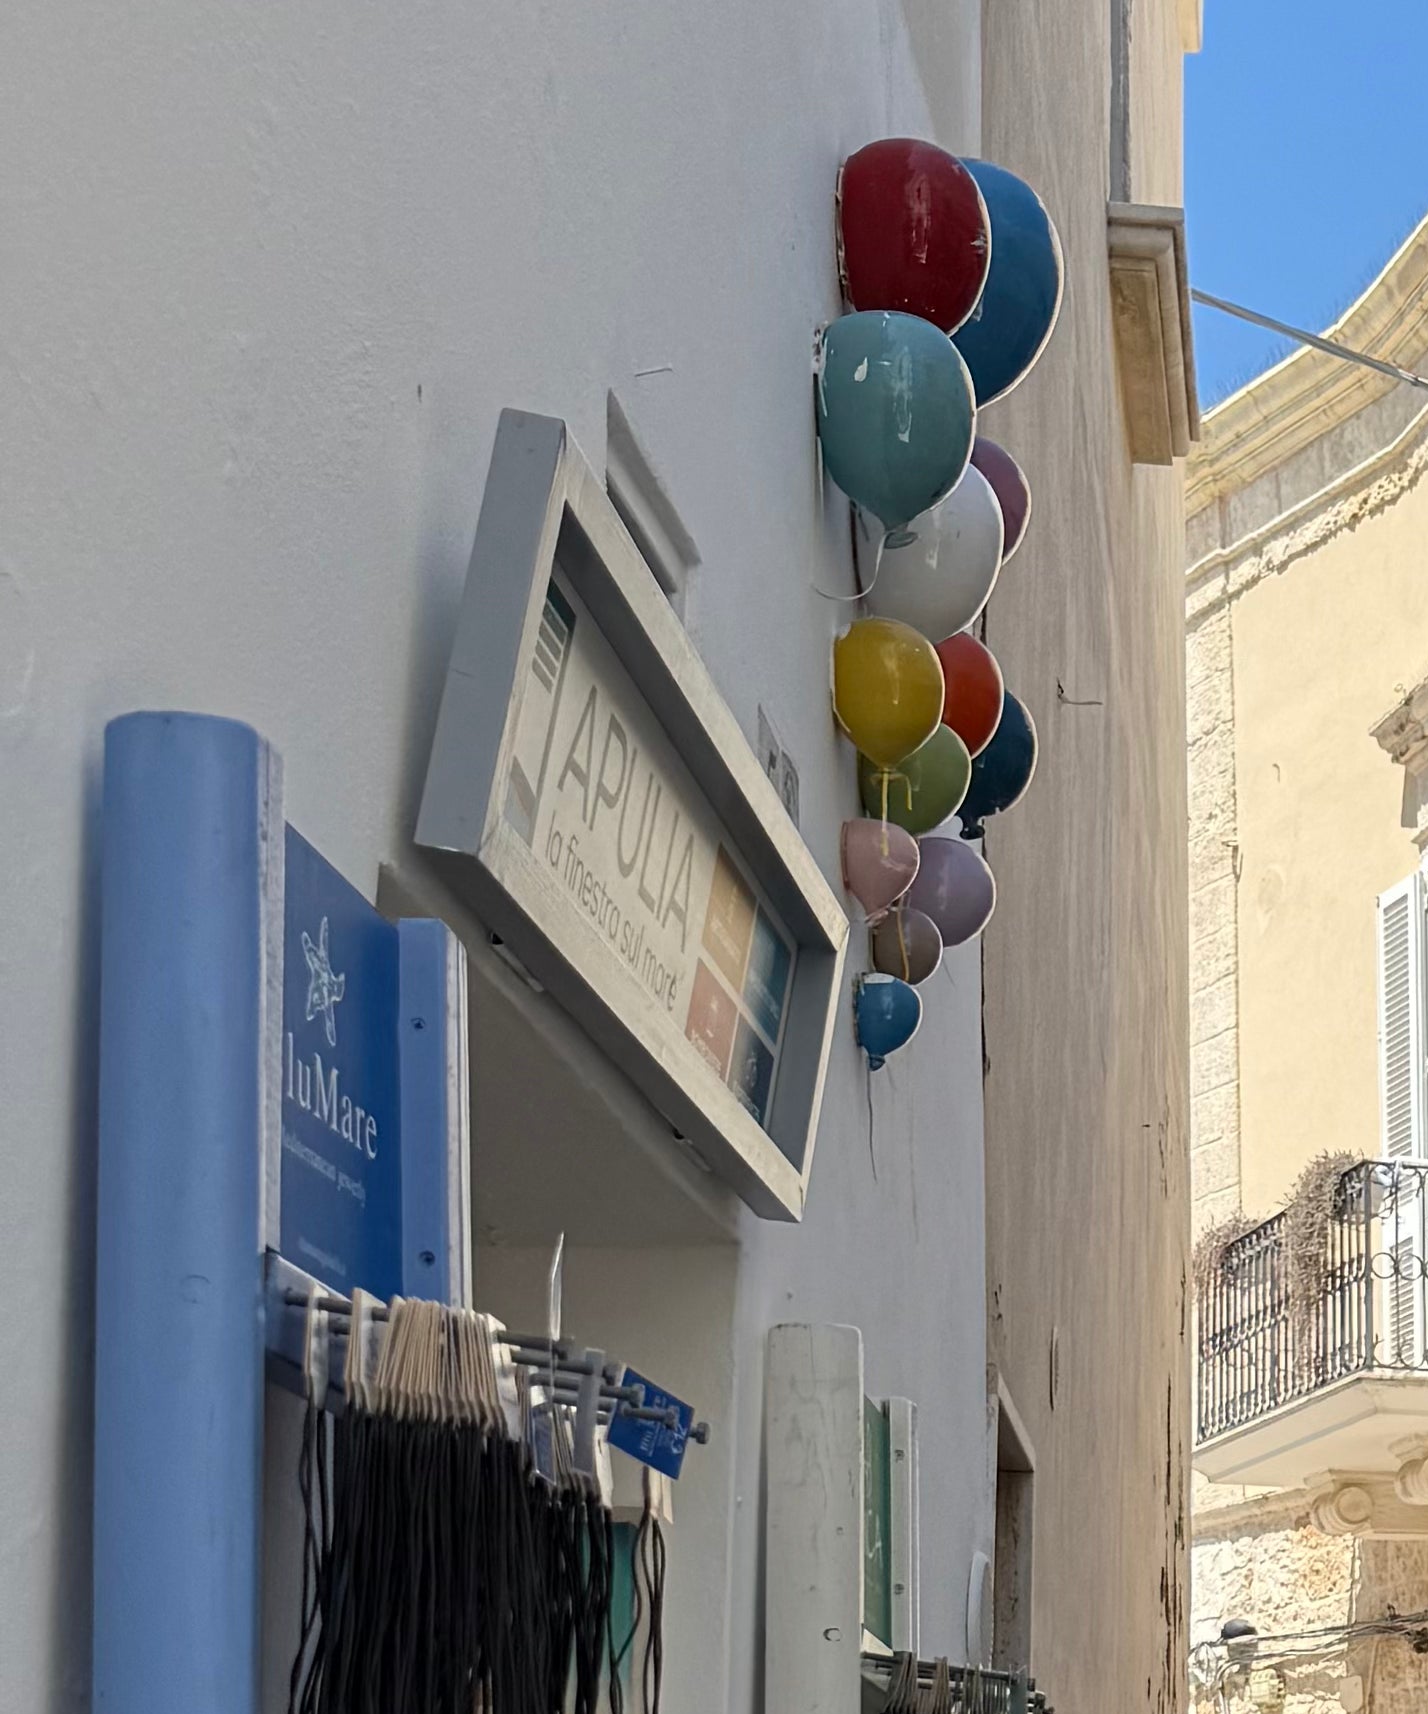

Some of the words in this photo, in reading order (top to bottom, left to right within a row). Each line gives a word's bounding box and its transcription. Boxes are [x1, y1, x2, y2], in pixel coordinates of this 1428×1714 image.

[544, 810, 562, 868] la
[562, 834, 620, 942] finestra
[620, 917, 643, 968] sul
[641, 947, 678, 1013] mare
[557, 684, 695, 953] APULIA
[286, 1031, 378, 1160] luMare
